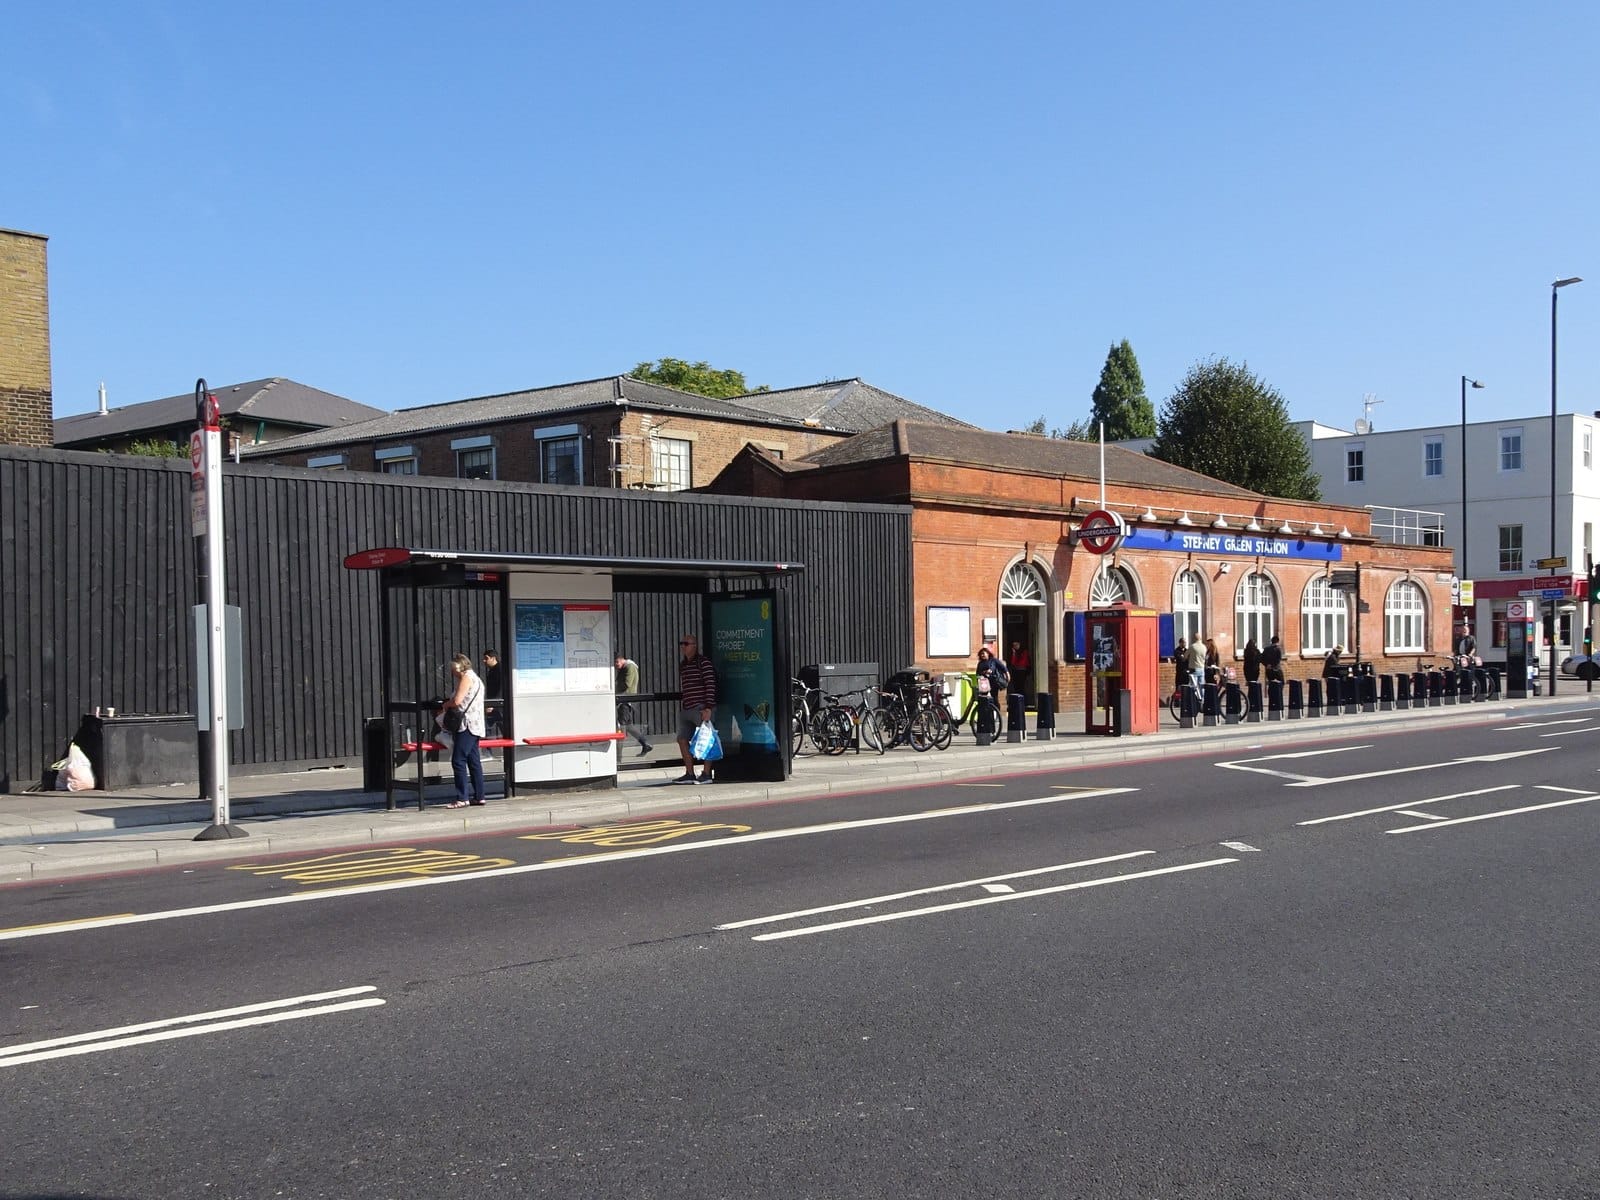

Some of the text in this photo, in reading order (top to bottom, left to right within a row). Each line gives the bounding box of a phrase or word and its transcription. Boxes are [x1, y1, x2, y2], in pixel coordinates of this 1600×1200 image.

[1078, 528, 1120, 537] UNDERGROUND
[1183, 535, 1289, 554] STEPNEY GREEN STATION
[715, 629, 765, 640] COMMITMENT
[719, 640, 745, 650] PHOBE?
[743, 651, 761, 661] FLEX
[516, 819, 753, 847] BUS
[224, 847, 517, 884] STOP
